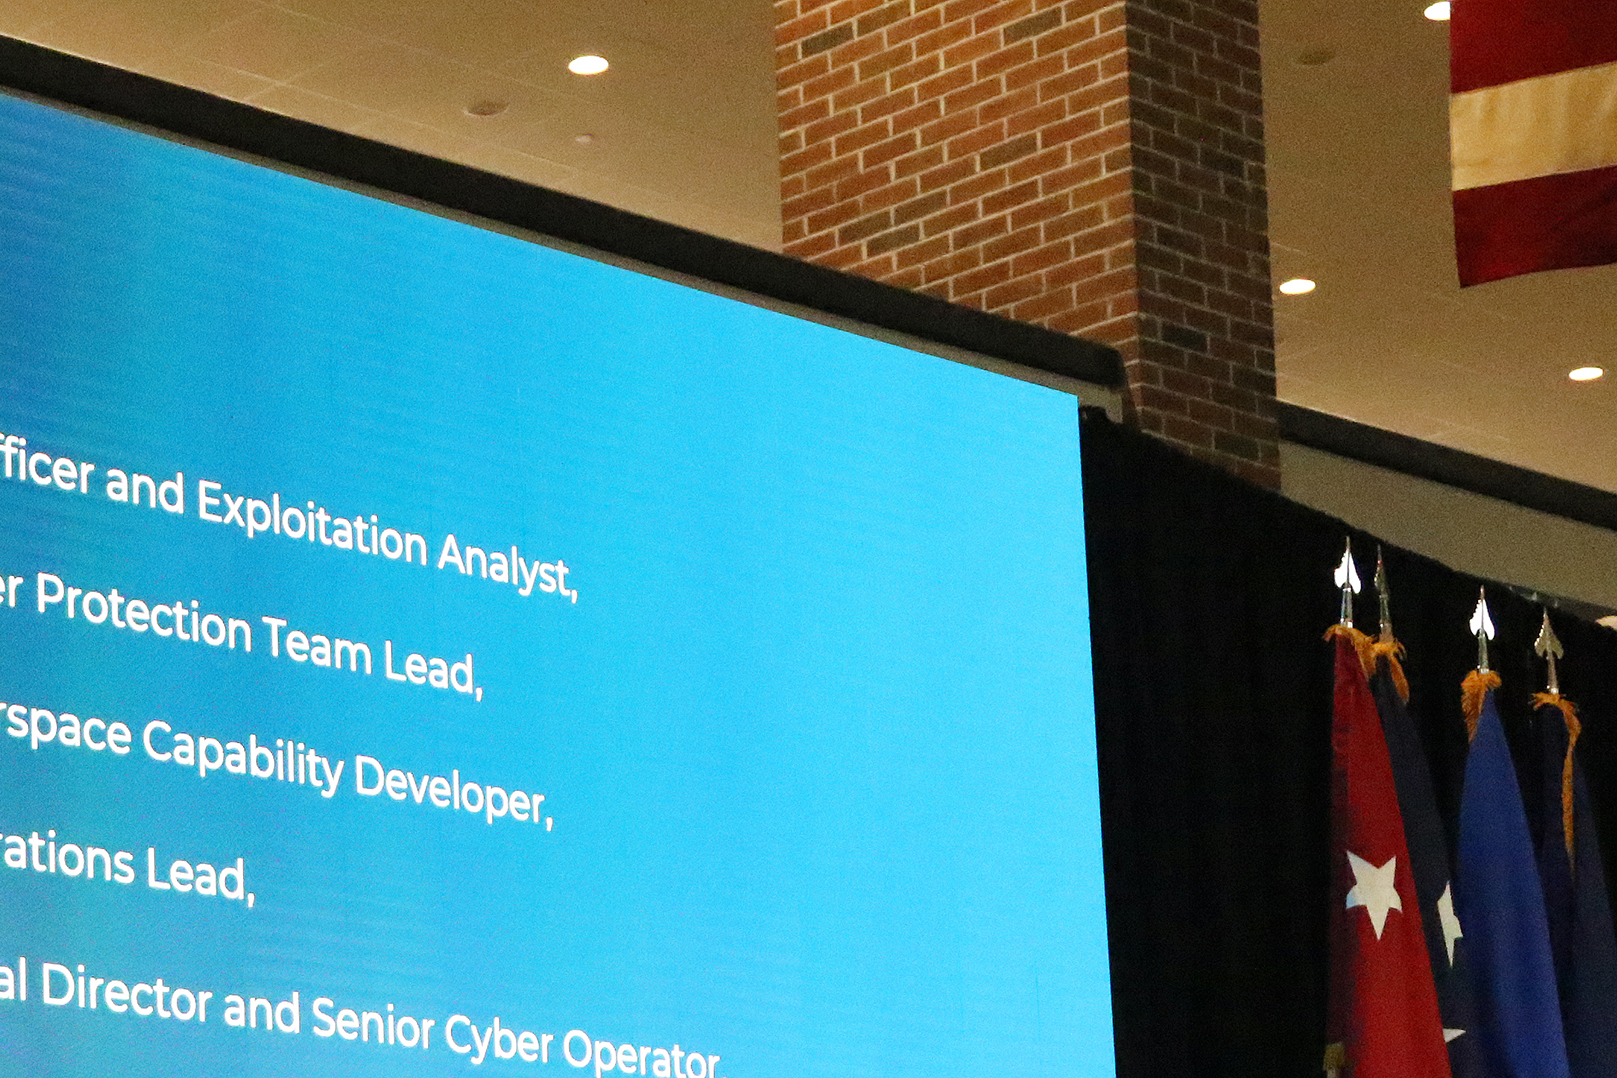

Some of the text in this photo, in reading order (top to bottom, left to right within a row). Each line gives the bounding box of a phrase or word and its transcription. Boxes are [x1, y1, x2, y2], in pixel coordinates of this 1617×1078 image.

[106, 469, 184, 514] and
[198, 479, 428, 566] Exploitation
[437, 533, 578, 604] Analyst,
[37, 572, 252, 652] Protection
[261, 616, 372, 675] Team
[385, 640, 483, 702] Lead,
[143, 720, 345, 799] Capability
[355, 754, 554, 832] Developer,
[147, 847, 255, 908] Lead,
[42, 962, 213, 1023] Director
[224, 991, 300, 1034] and
[312, 997, 436, 1049] Senior
[445, 1014, 554, 1065] Cyber
